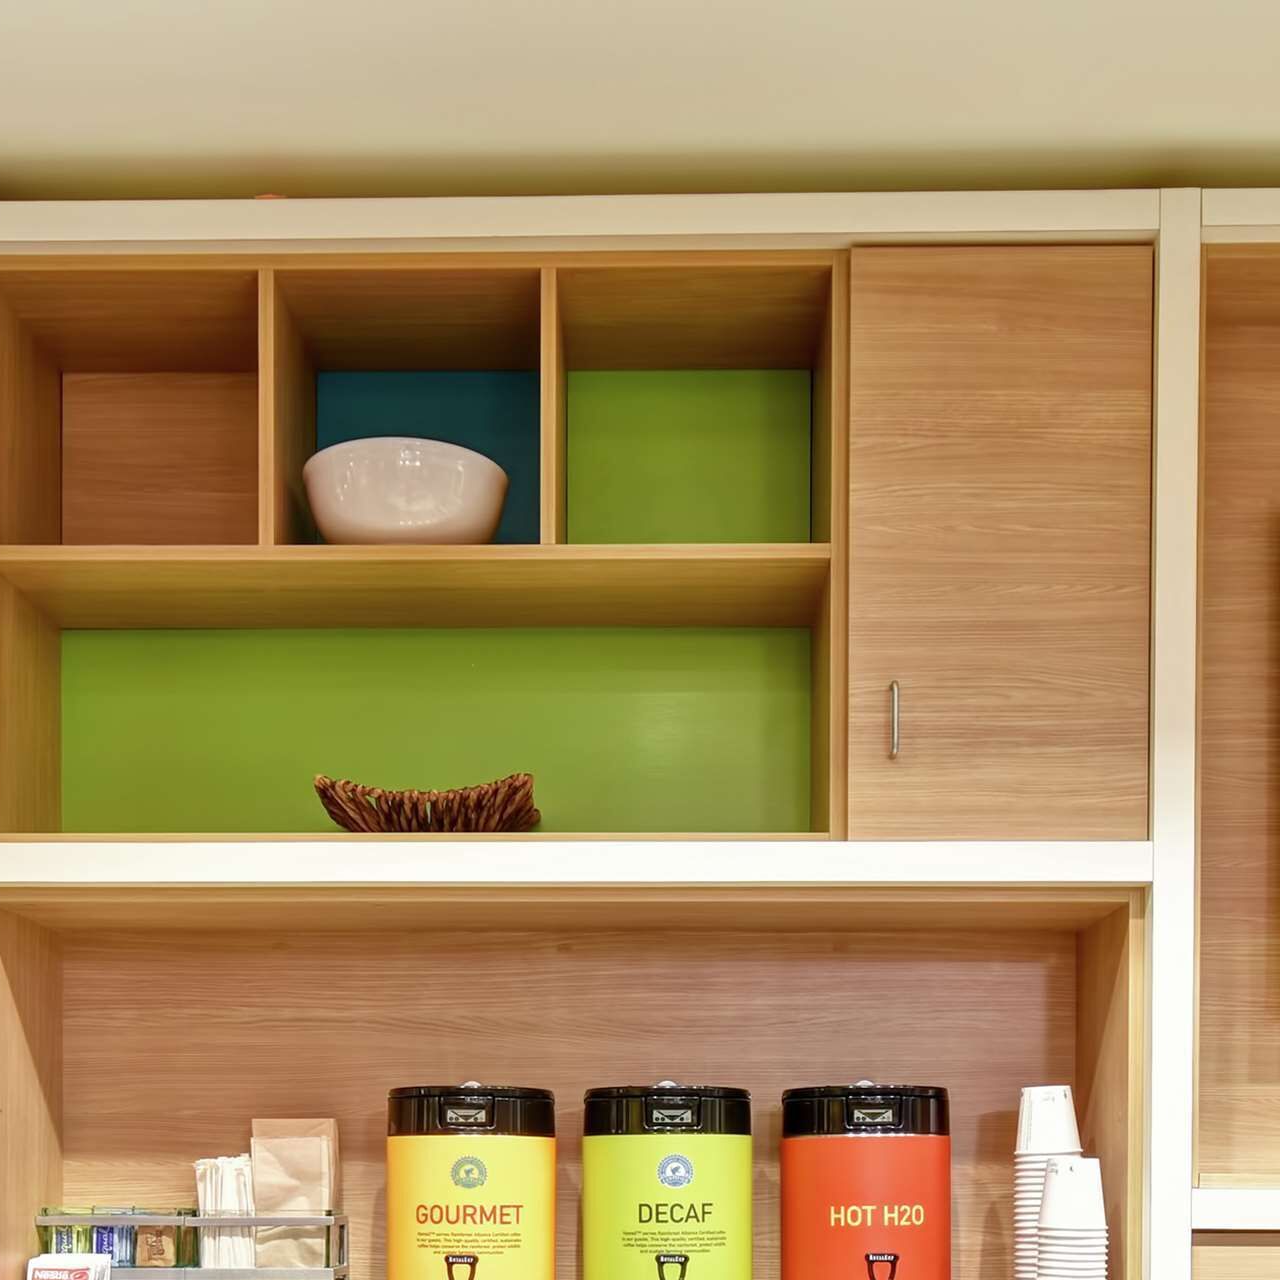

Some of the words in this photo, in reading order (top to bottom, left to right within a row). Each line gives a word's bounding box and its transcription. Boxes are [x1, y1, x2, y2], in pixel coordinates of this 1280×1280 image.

[416, 1204, 524, 1225] GOURMET
[638, 1202, 714, 1224] DECAF
[830, 1204, 877, 1226] HOT
